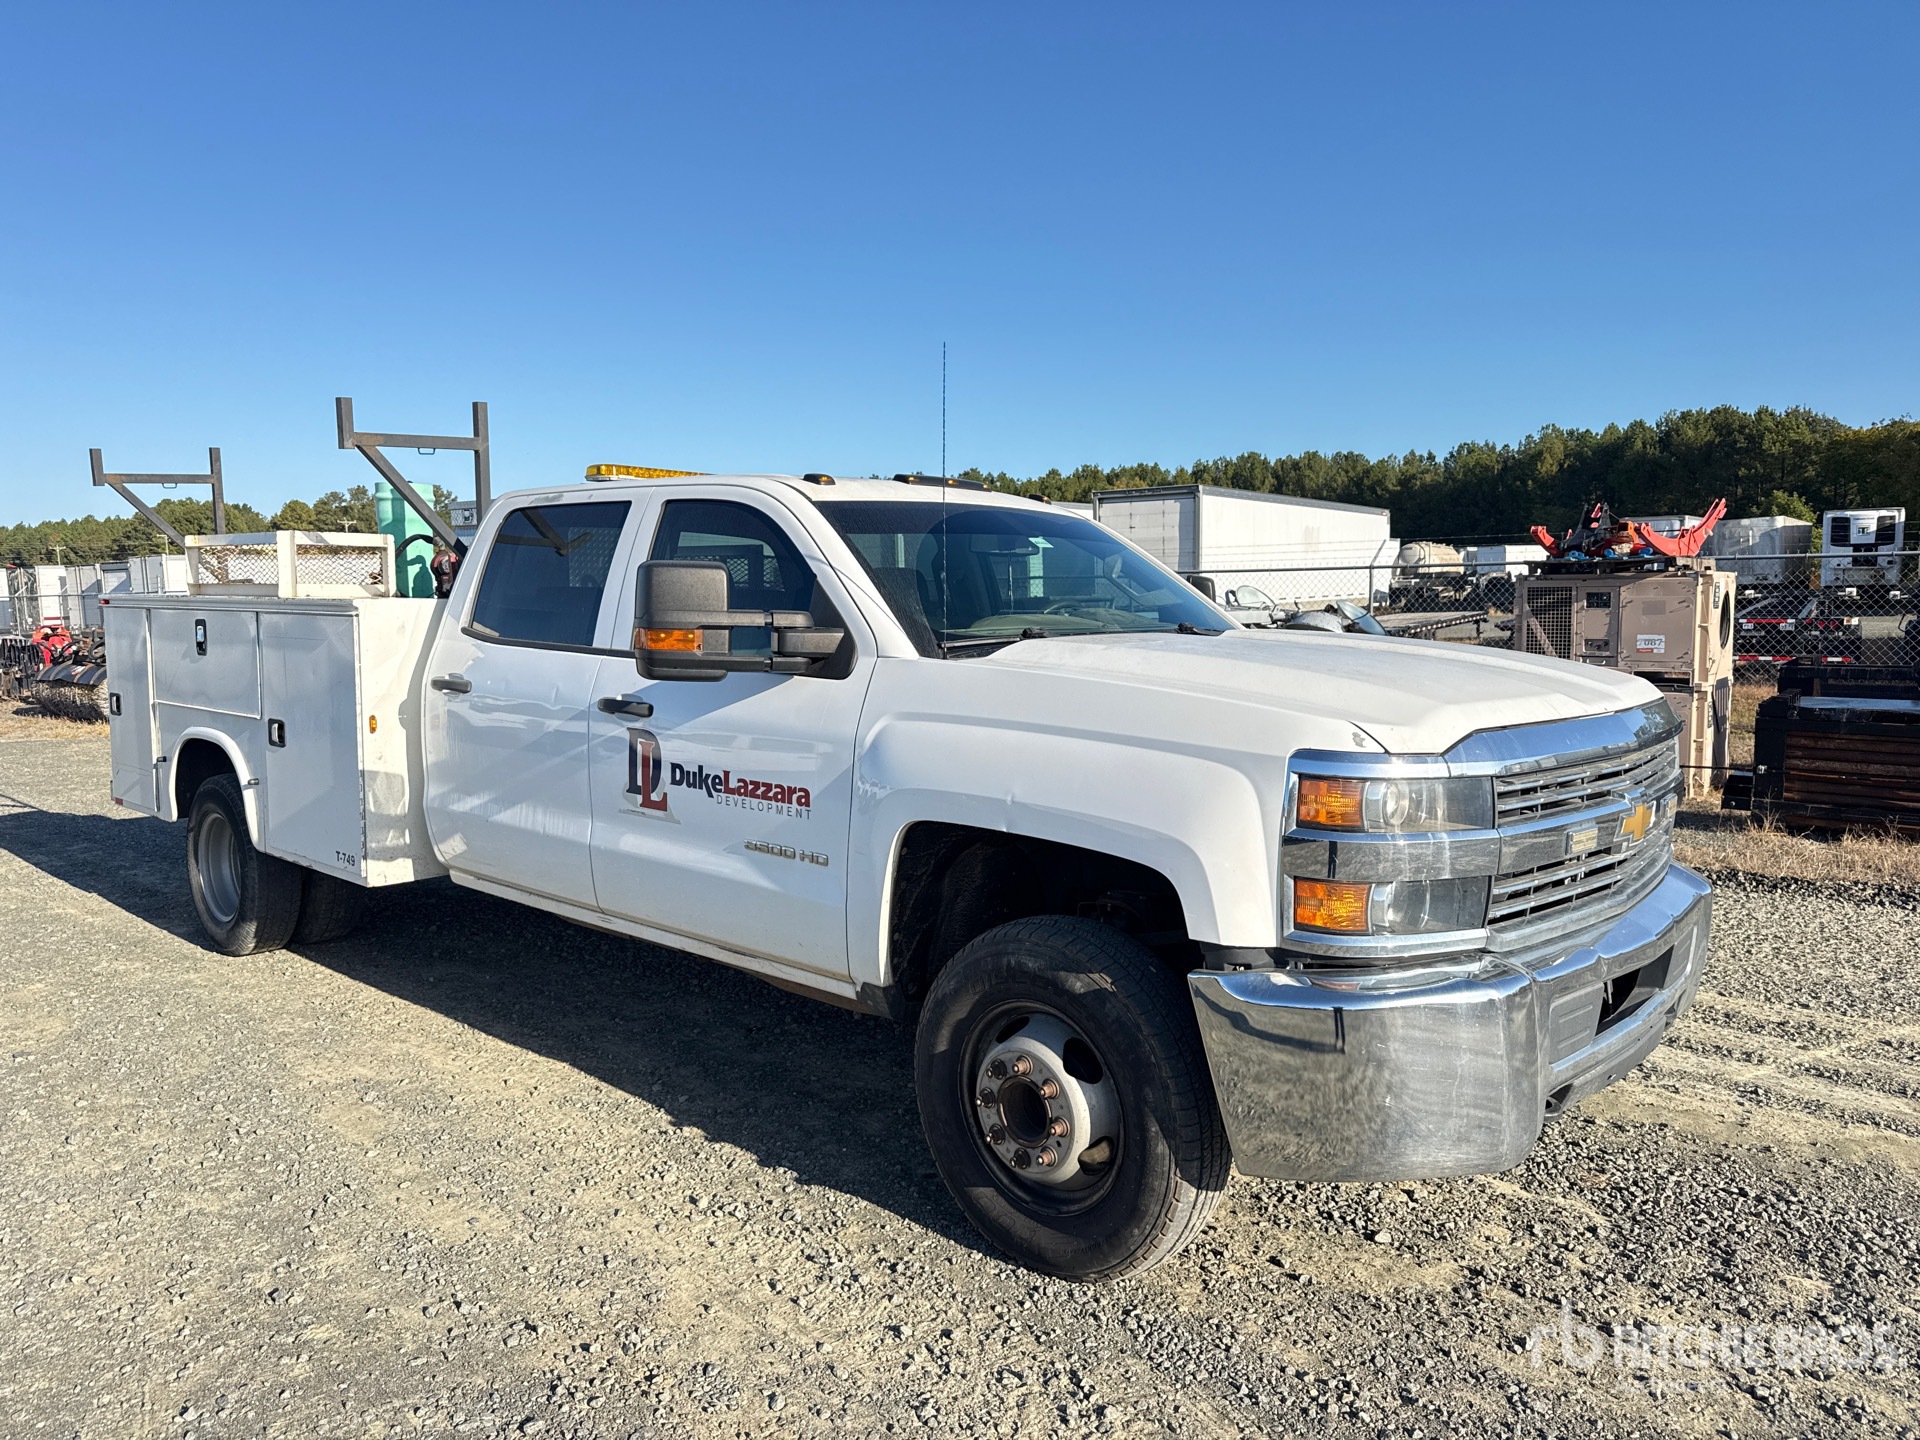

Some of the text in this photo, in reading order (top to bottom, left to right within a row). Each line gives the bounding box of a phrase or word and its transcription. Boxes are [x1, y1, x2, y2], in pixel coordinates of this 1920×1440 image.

[669, 762, 811, 808] DukeLazzara
[716, 795, 812, 820] DEVELOPMENT
[335, 850, 356, 867] T-749
[743, 839, 829, 867] 3500 HD
